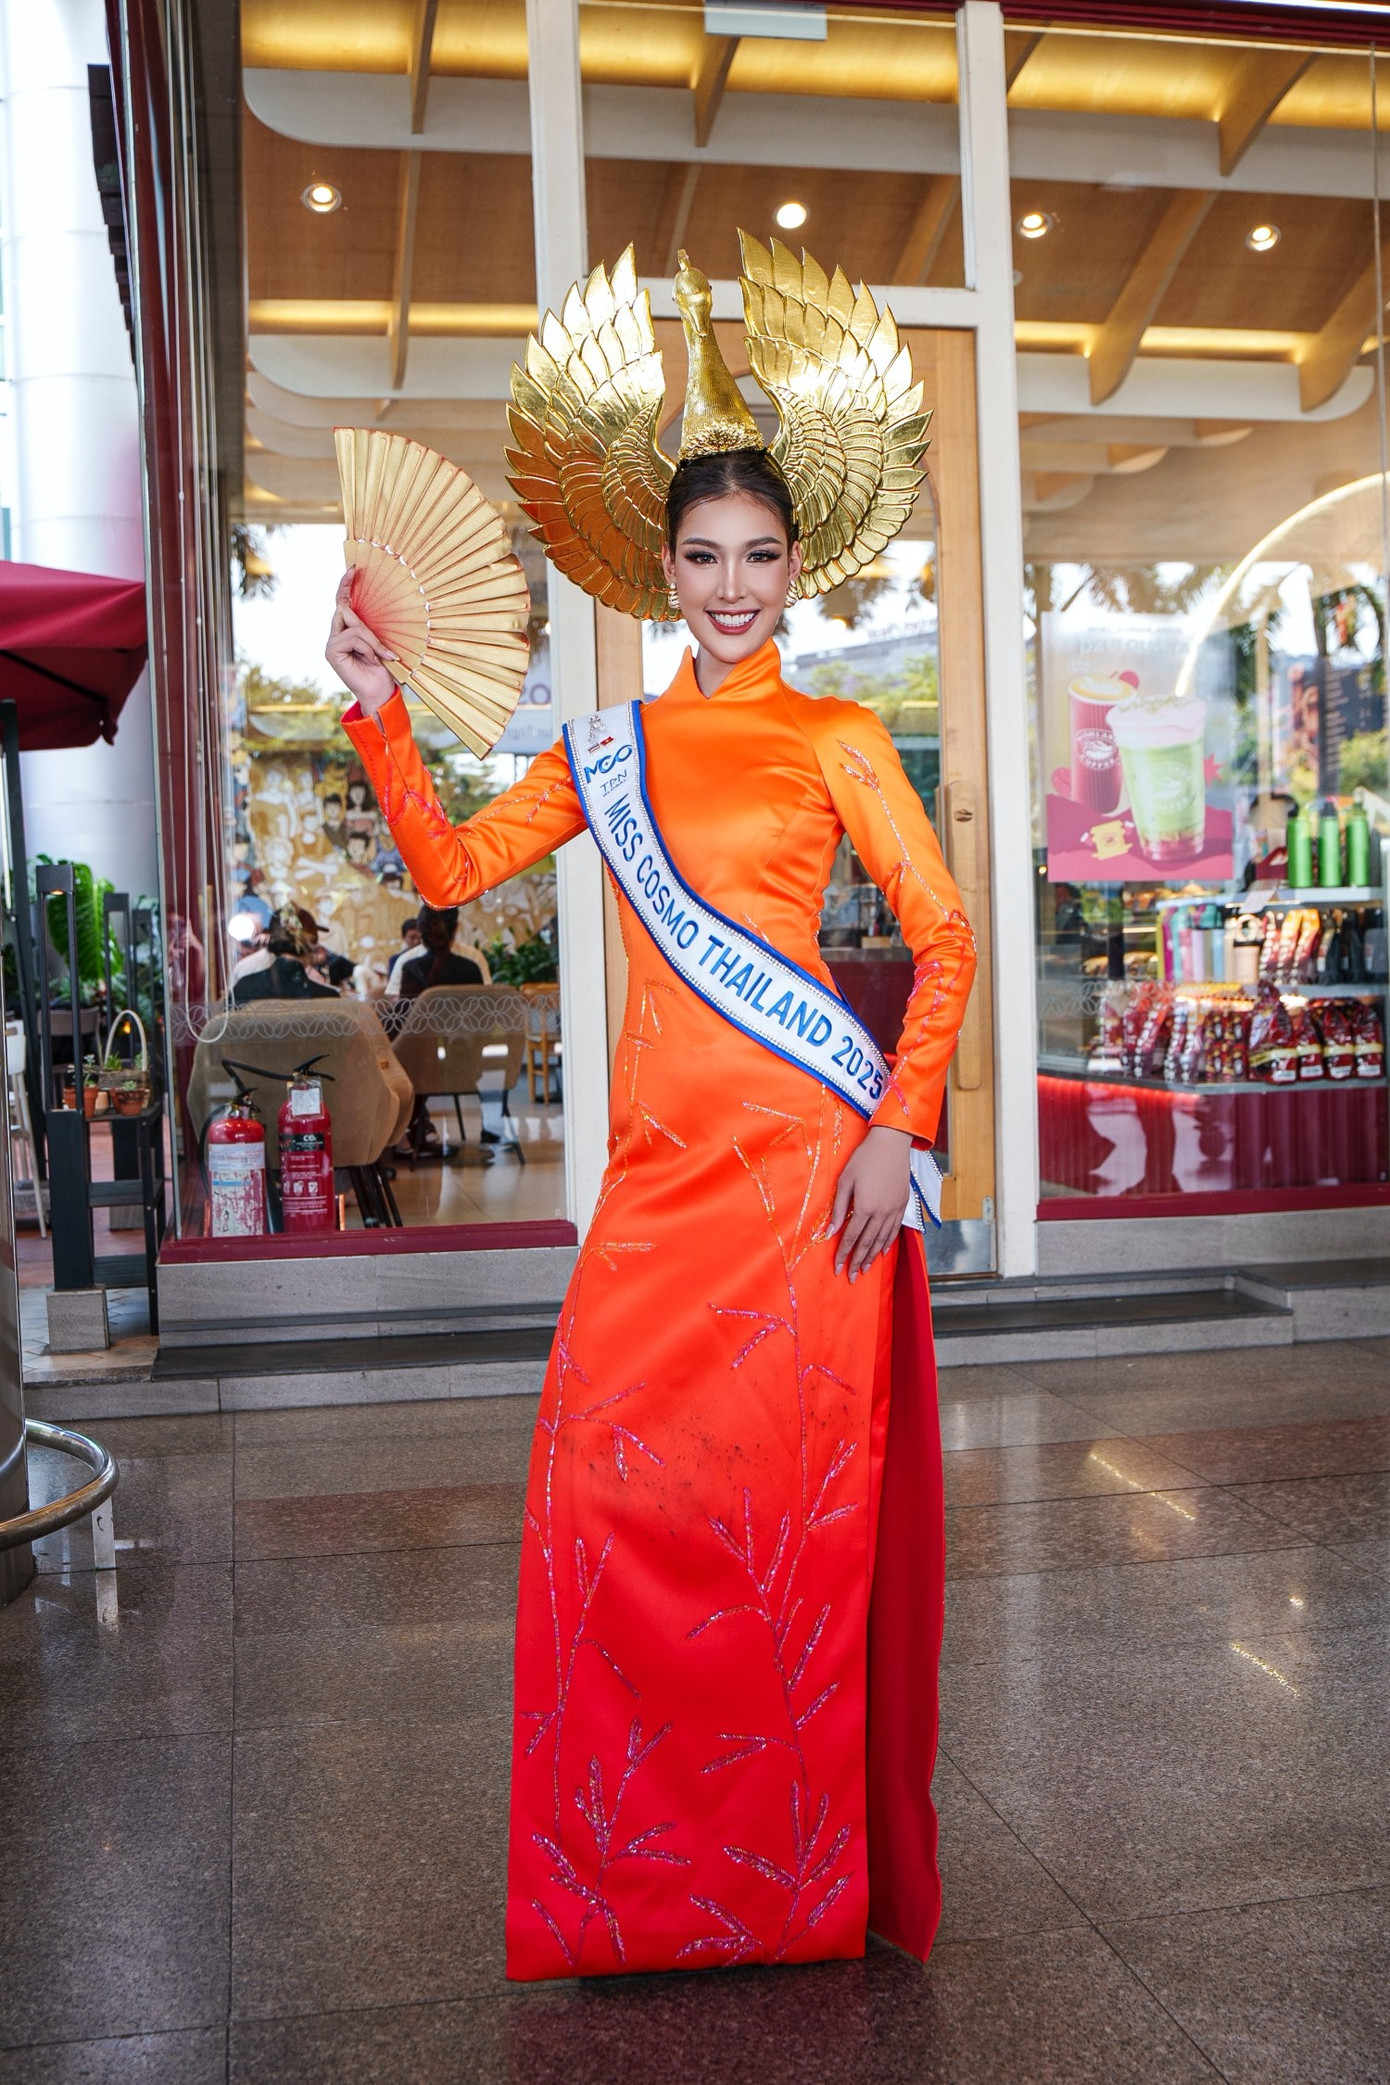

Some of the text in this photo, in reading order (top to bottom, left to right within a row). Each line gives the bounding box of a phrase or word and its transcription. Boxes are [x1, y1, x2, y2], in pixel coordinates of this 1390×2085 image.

[600, 769, 627, 792] TPN
[604, 793, 884, 1100] MISS COSMO THAILAND 2025
